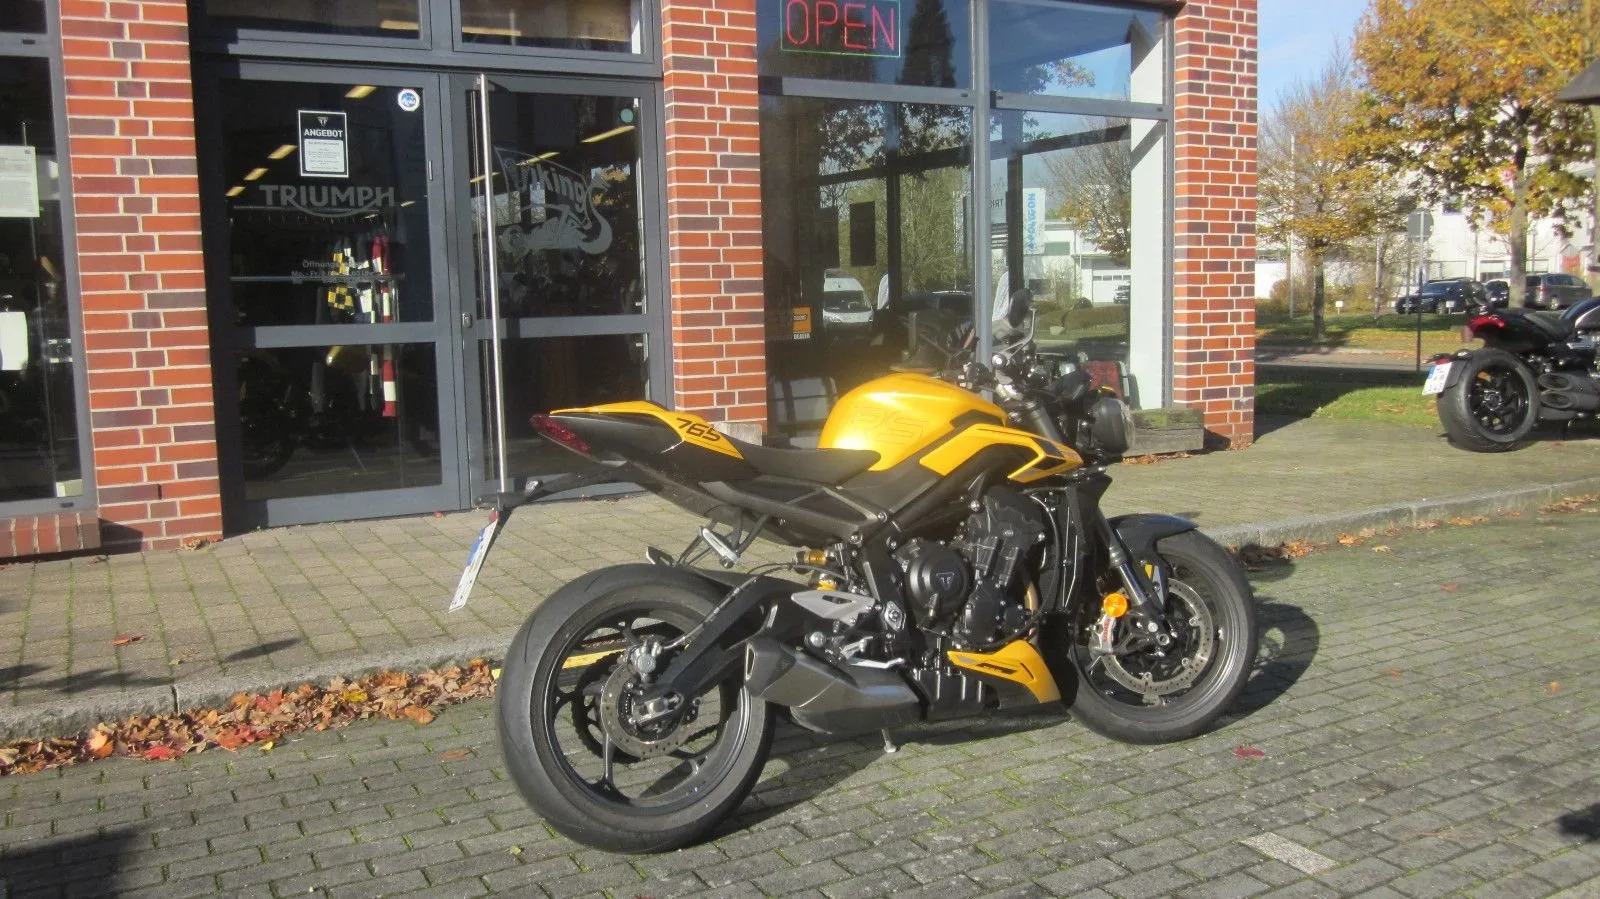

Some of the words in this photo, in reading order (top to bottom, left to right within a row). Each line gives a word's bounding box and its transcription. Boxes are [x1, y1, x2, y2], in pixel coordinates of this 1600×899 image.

[785, 0, 896, 51] OPEN
[304, 128, 343, 138] ANGEBOT
[259, 184, 395, 215] TRIUMPH
[676, 417, 721, 442] 765
